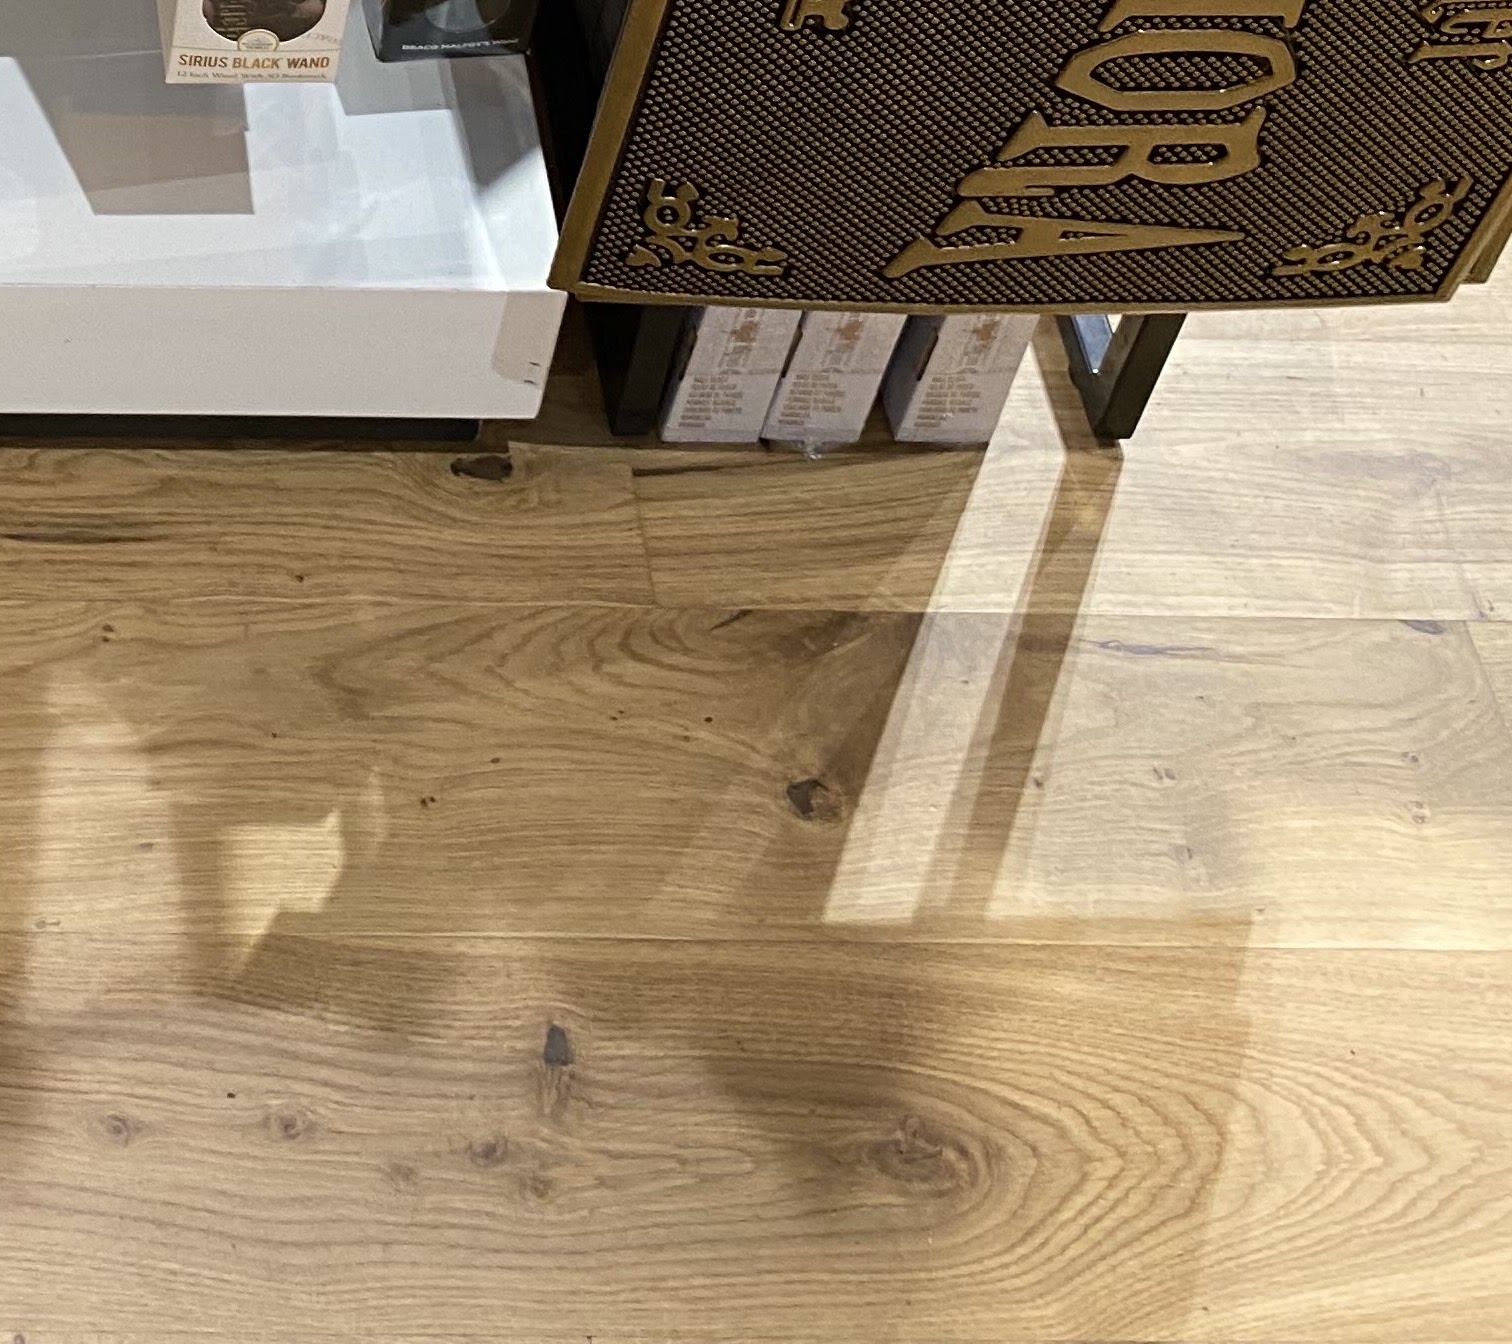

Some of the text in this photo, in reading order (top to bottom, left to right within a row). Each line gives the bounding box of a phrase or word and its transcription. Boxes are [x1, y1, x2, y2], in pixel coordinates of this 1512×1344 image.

[401, 43, 439, 51] DRACO
[178, 53, 331, 70] SIRIUS BLACK WAND
